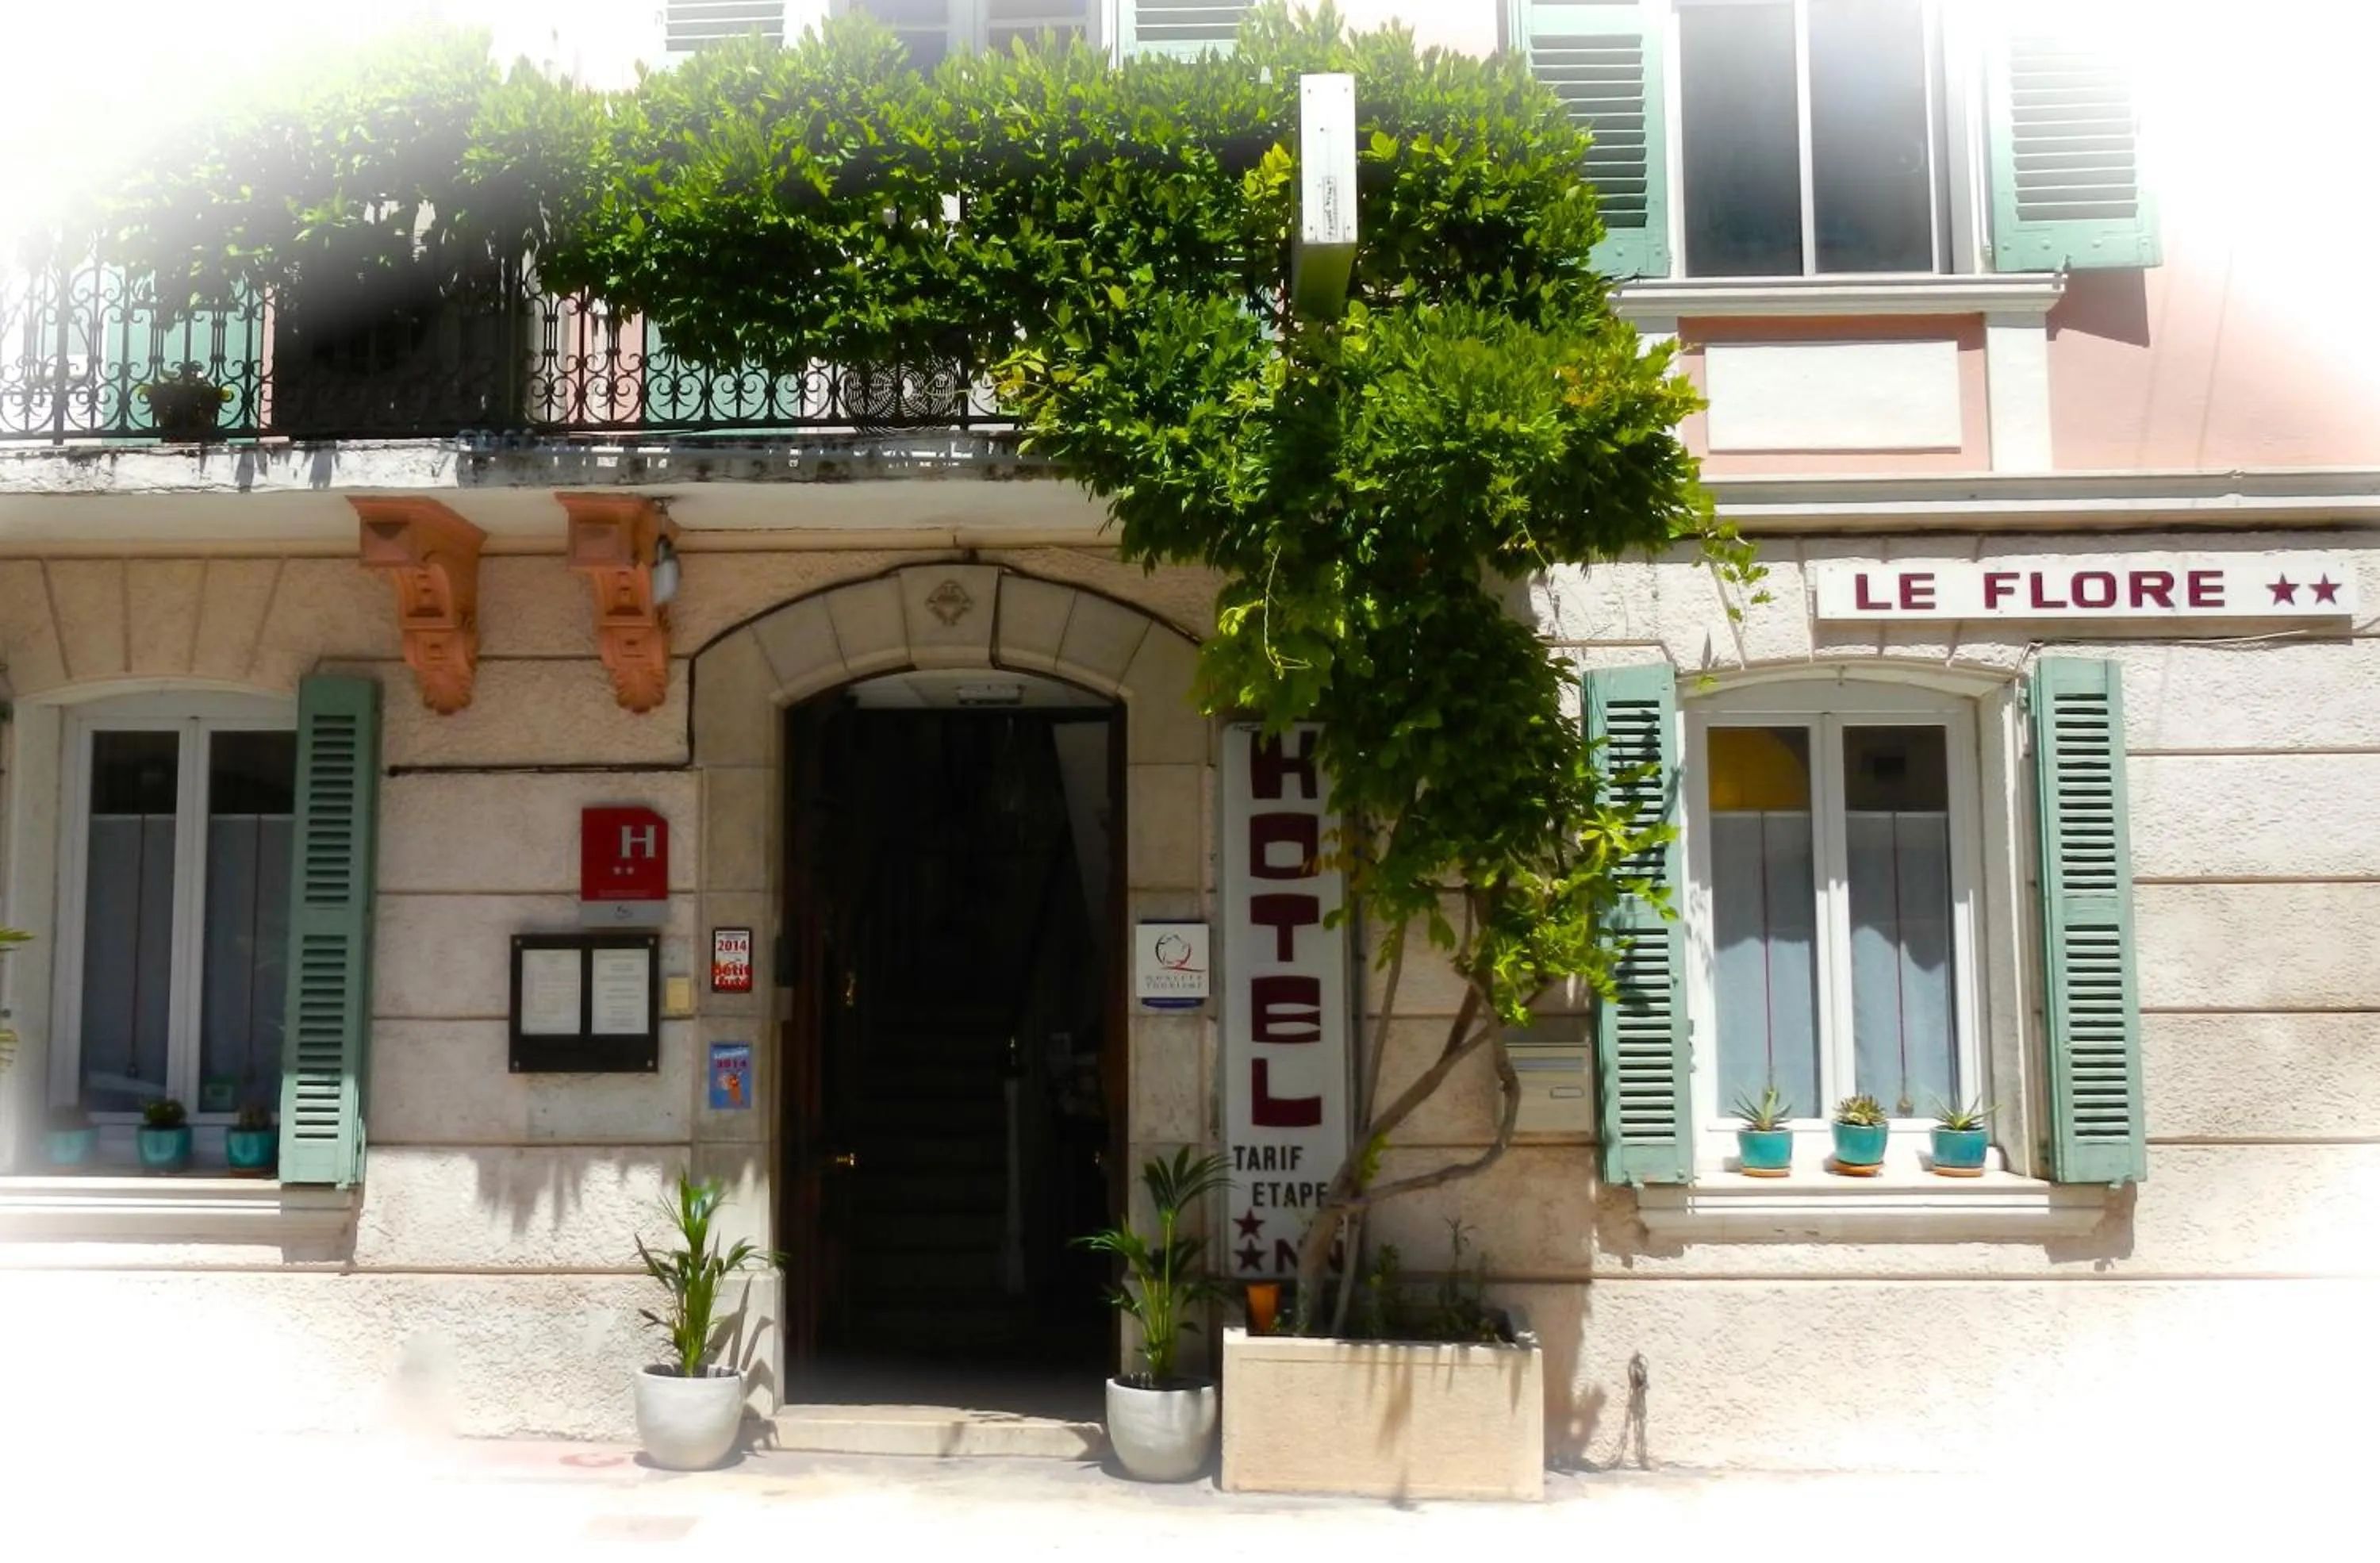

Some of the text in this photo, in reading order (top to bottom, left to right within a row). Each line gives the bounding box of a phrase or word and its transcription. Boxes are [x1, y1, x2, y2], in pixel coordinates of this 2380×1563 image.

[1855, 570, 2225, 610] LE FLORE
[621, 824, 655, 858] H
[717, 939, 747, 951] 2014
[1250, 729, 1322, 1127] HOTEL
[1233, 1146, 1303, 1171] TARIF
